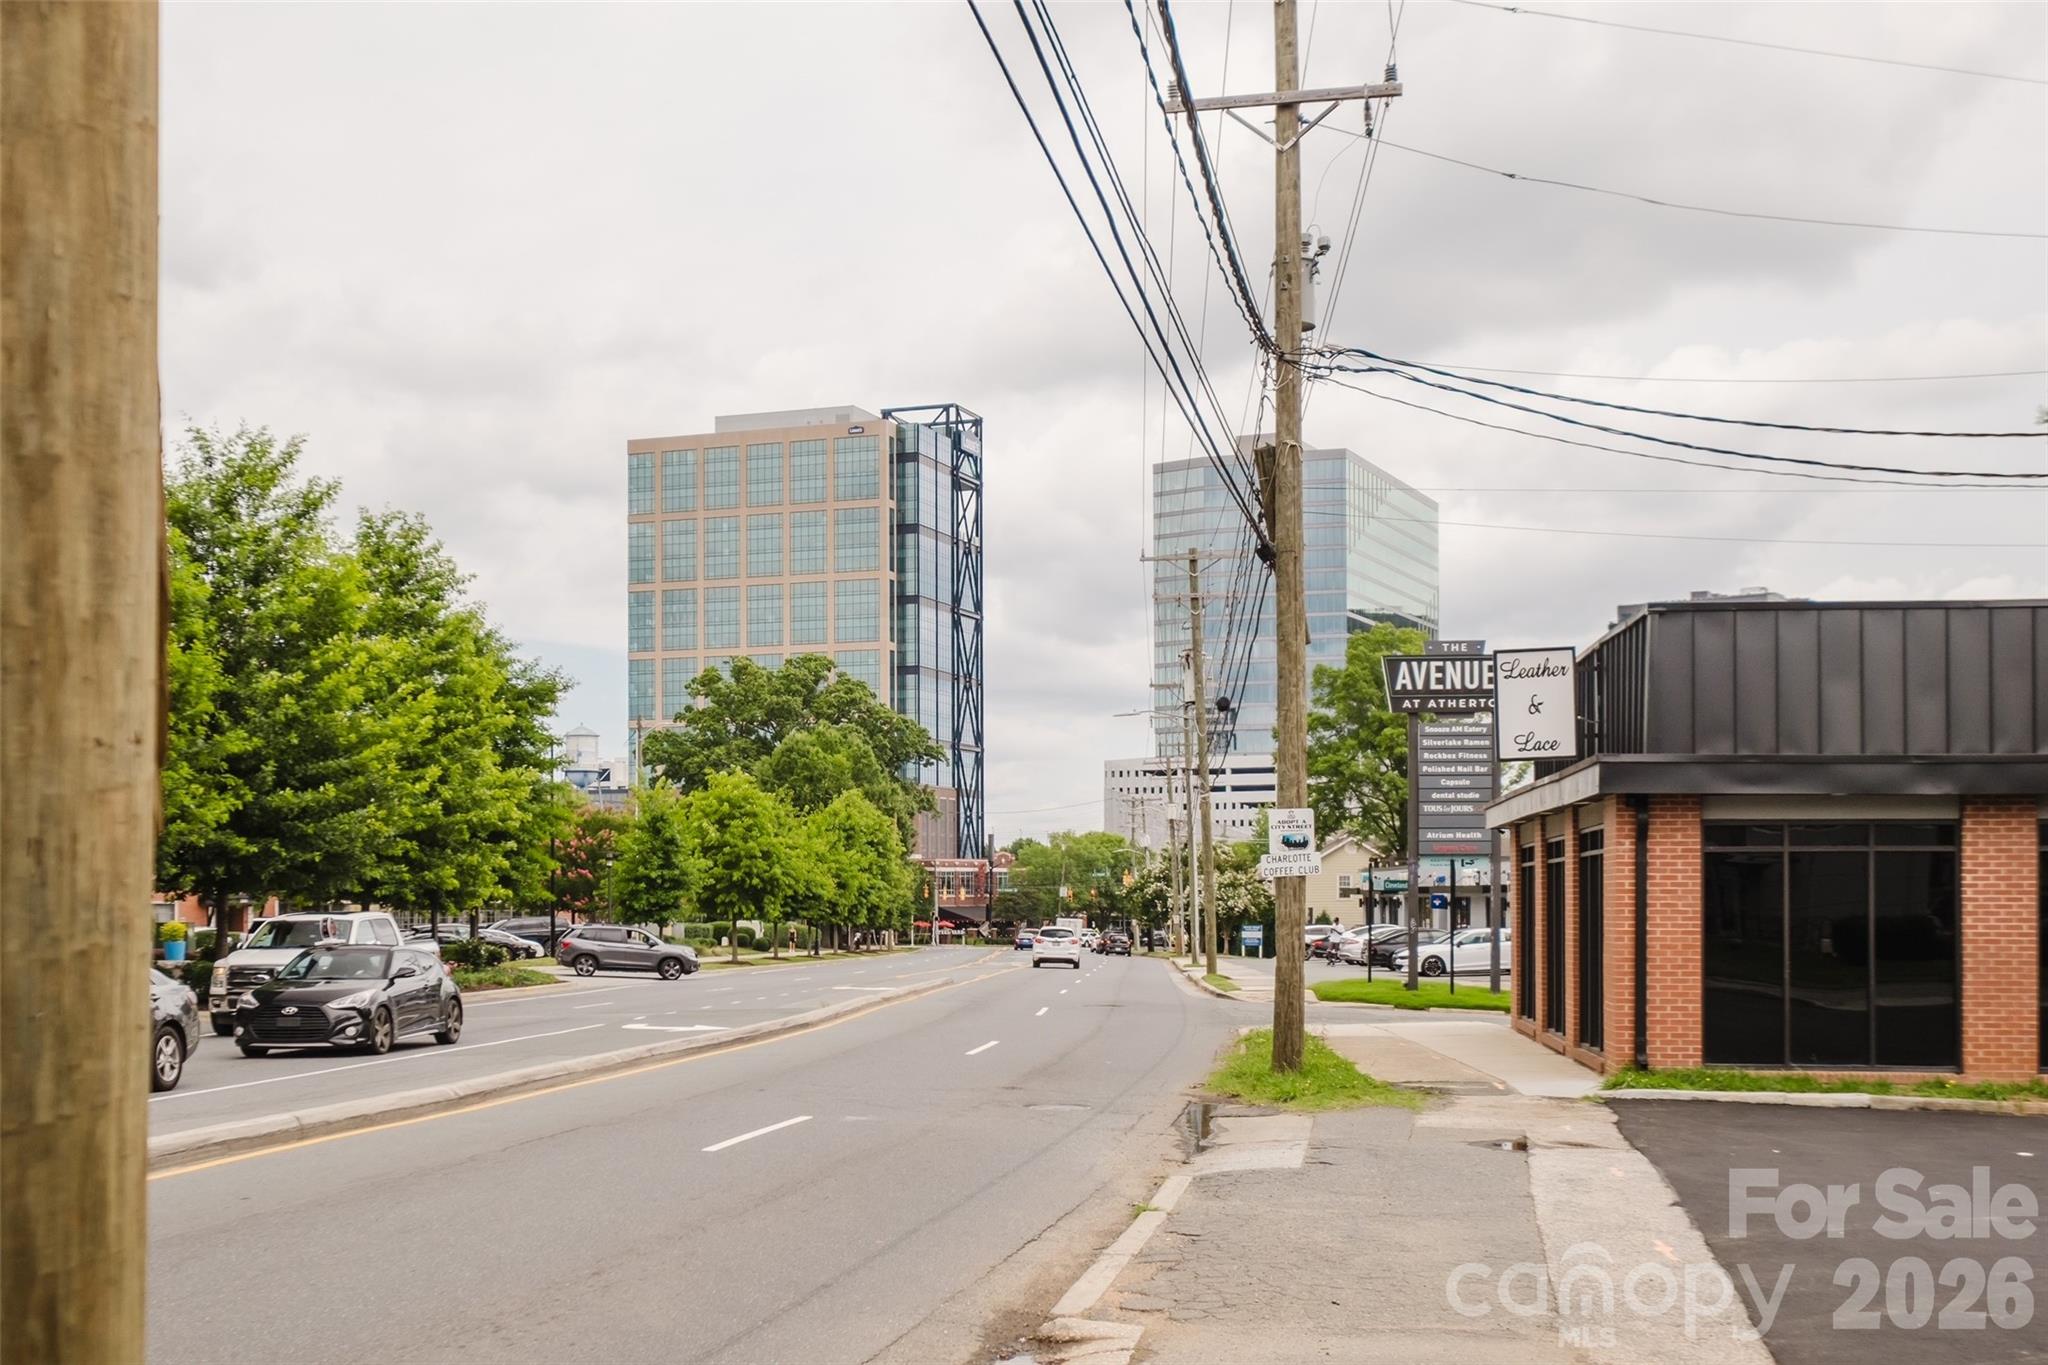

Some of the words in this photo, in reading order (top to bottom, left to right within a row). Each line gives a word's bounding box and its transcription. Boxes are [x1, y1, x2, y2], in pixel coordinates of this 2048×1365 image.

[1442, 643, 1467, 652] THE
[1500, 657, 1569, 680] Leather
[1395, 661, 1494, 690] AVENUE
[1402, 699, 1421, 708] AT
[1427, 698, 1494, 708] ATHERTO
[1528, 694, 1544, 715] &
[1464, 726, 1487, 734] Eatery
[1463, 739, 1490, 747] Ramen
[1514, 731, 1560, 752] Lace
[1423, 752, 1456, 760] Rockbox
[1458, 752, 1487, 760] Fitness
[1422, 765, 1455, 773] Polished
[1457, 765, 1473, 773] Nail
[1440, 778, 1470, 787] Capsule
[1457, 791, 1480, 799] studio
[1450, 805, 1474, 814] JOURS
[1427, 831, 1454, 839] Atrium
[1456, 831, 1482, 839] Health
[1266, 853, 1312, 864] CHARLOTTE
[1263, 866, 1294, 877] COFFEE
[1298, 865, 1320, 874] CLUB
